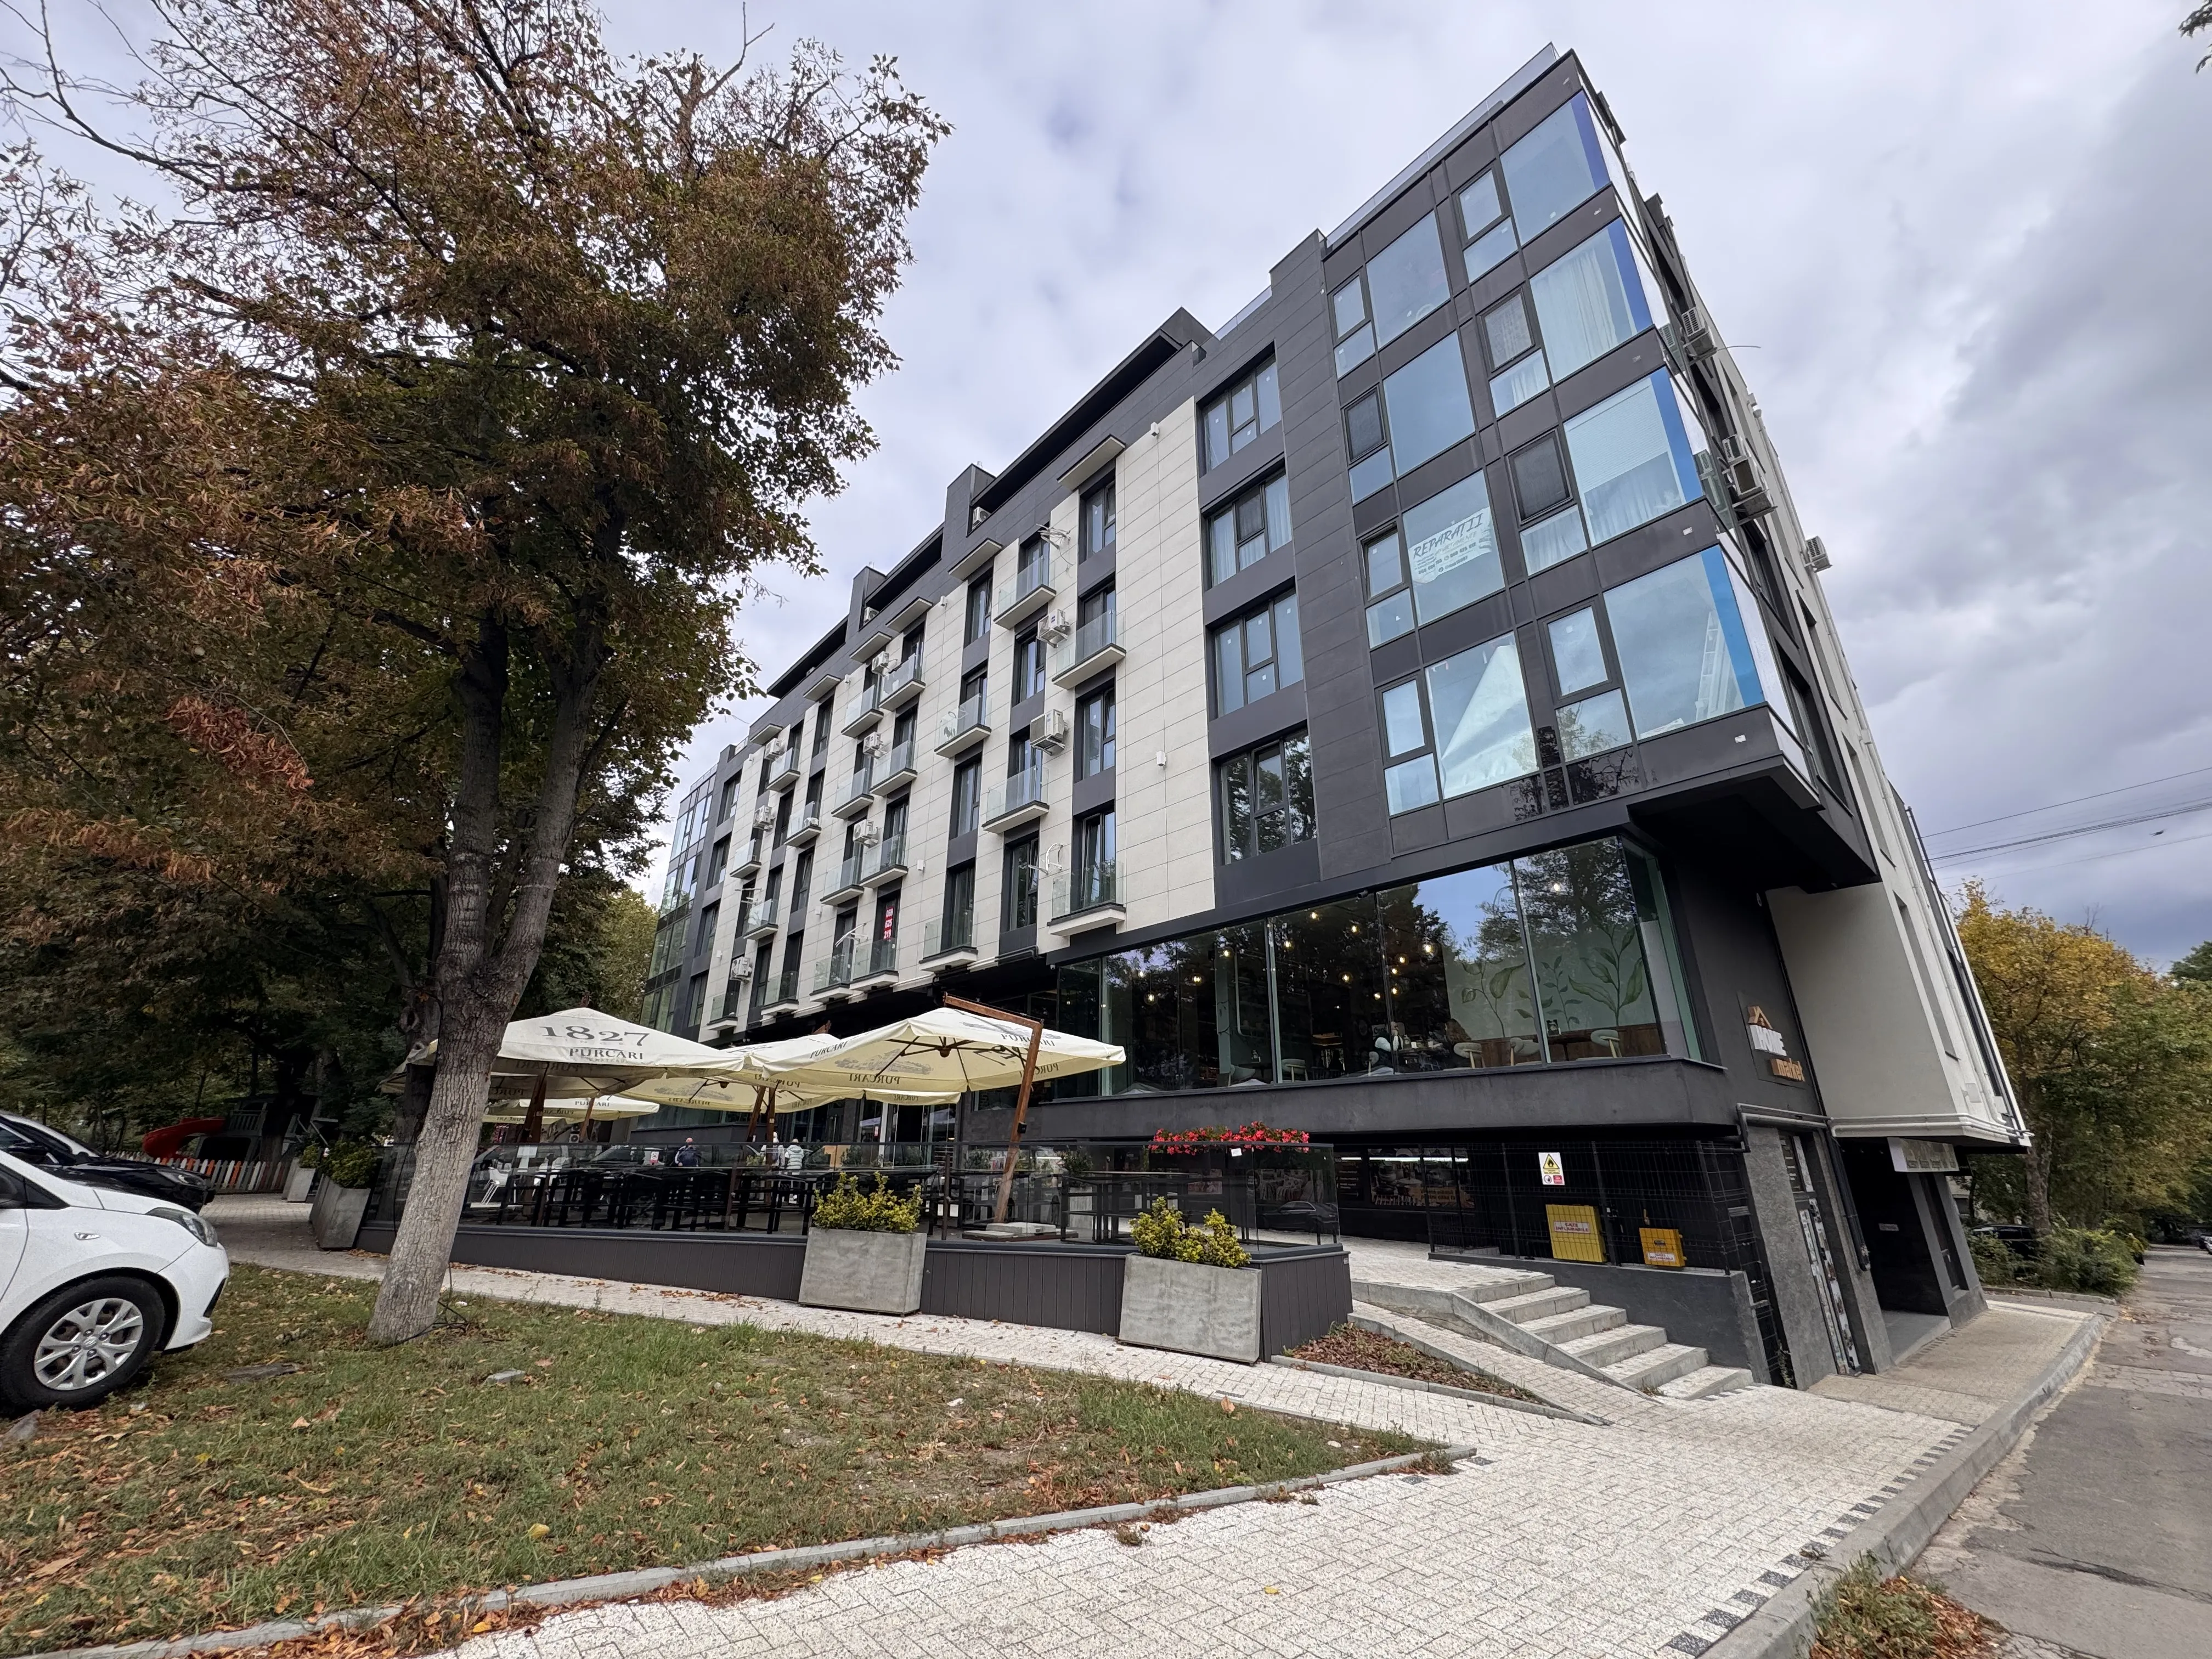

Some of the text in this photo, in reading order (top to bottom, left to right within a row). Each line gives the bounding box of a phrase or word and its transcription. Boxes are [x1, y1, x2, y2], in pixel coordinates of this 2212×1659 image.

[539, 1026, 650, 1046] 1827
[569, 1048, 643, 1059] PURCARI
[810, 1041, 848, 1059] PURCARI
[1773, 1058, 1805, 1081] market
